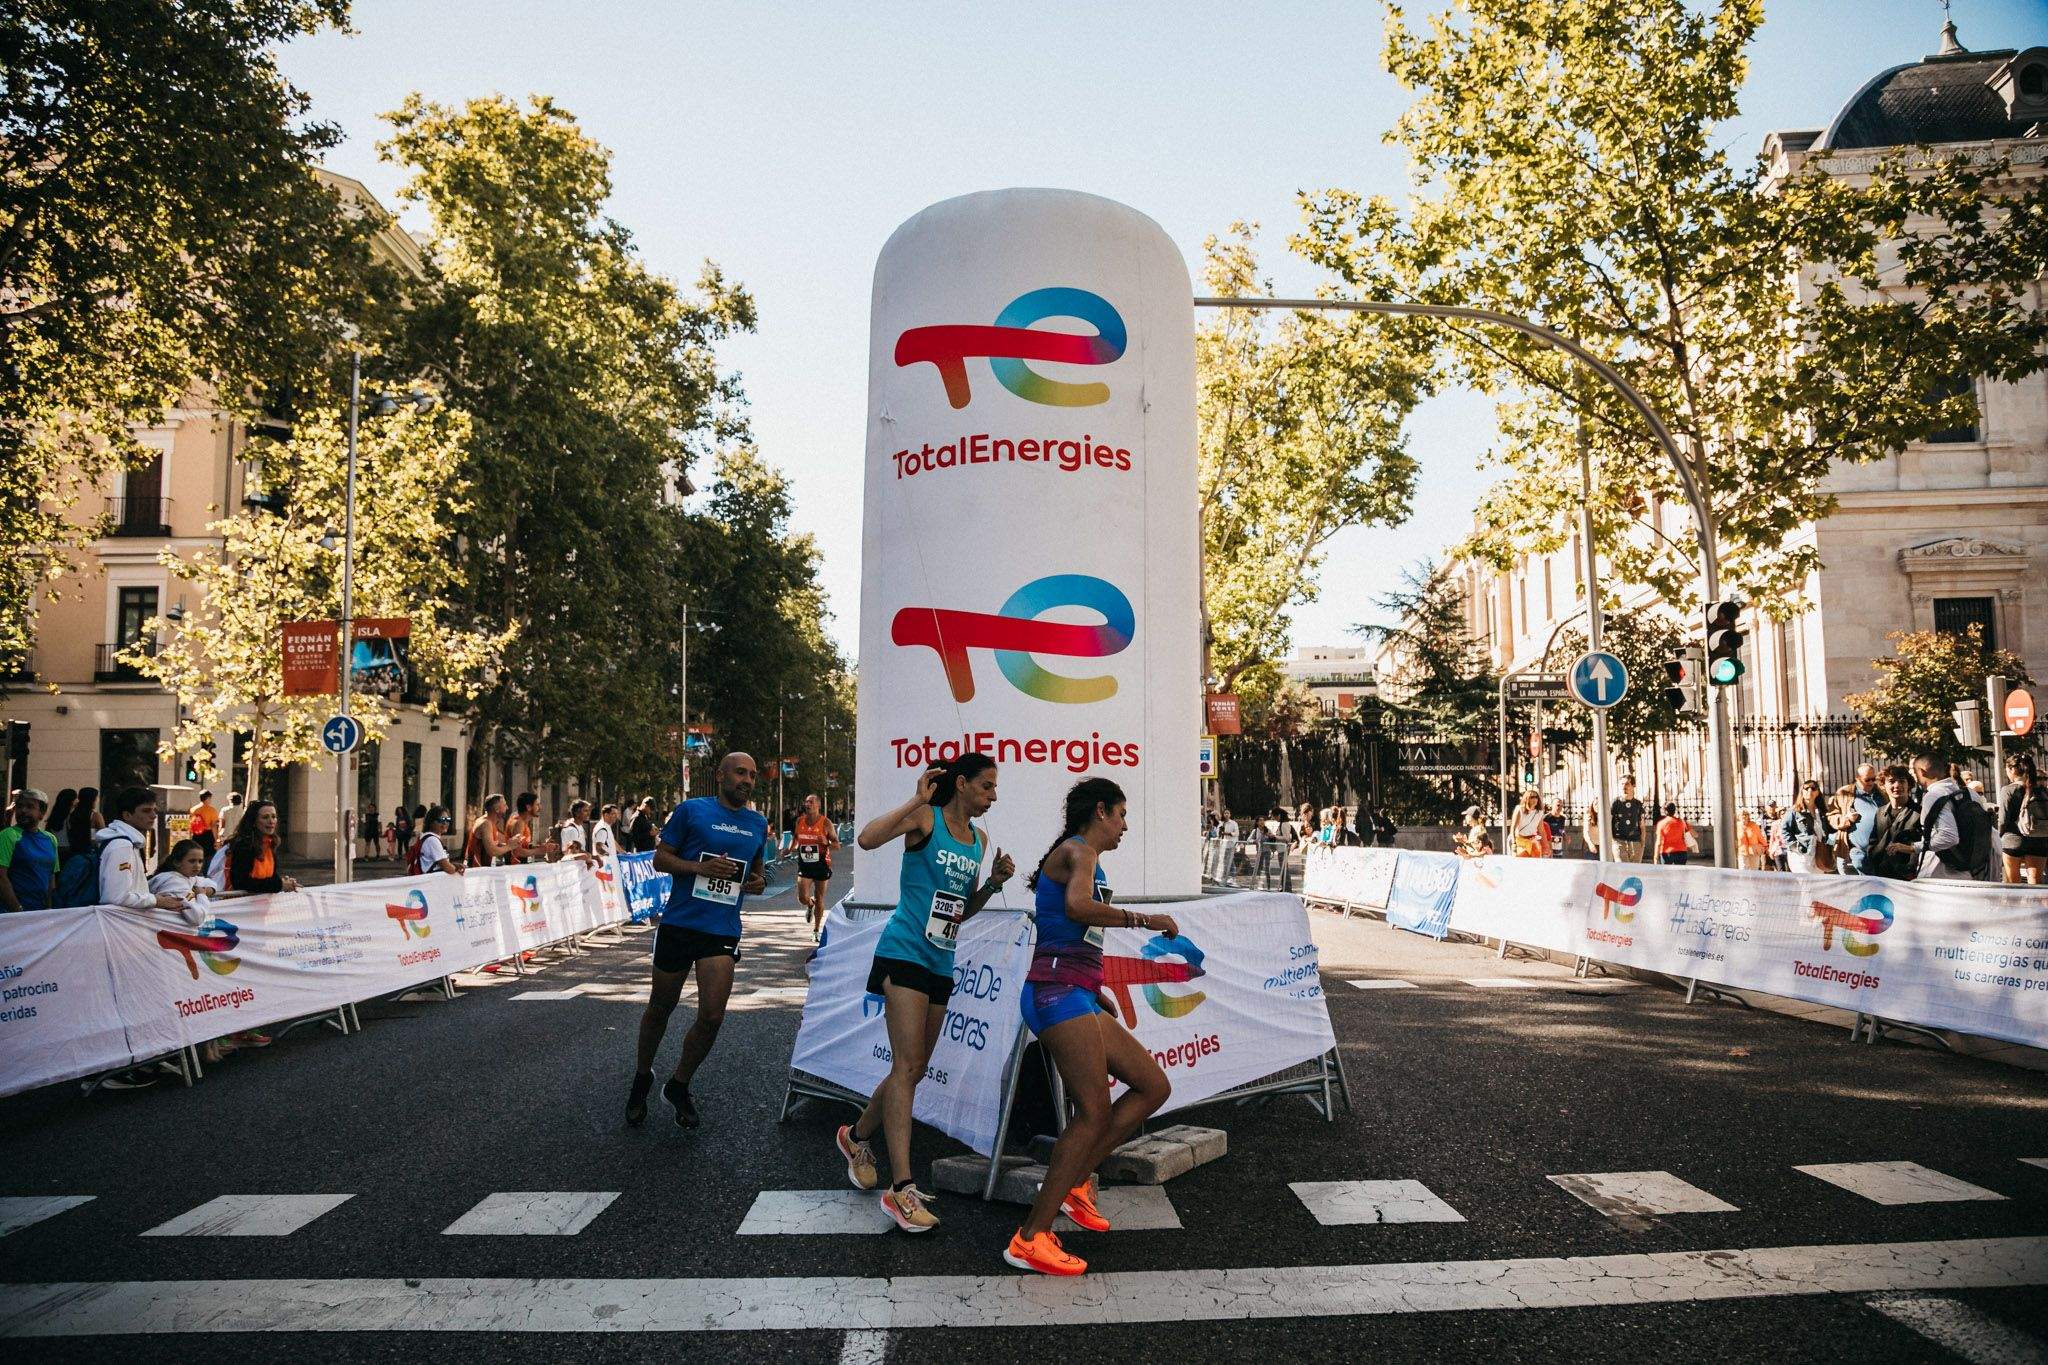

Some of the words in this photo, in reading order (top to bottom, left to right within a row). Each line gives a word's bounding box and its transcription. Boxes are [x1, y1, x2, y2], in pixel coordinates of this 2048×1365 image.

[892, 434, 1132, 480] TotalEnergies
[287, 632, 332, 644] FERNÁN
[357, 627, 381, 636] ISLA
[287, 643, 331, 653] GÓMEZ
[707, 879, 732, 895] 595
[935, 900, 954, 913] 3205
[1586, 927, 1634, 948] TotalEnergies
[1970, 931, 2009, 946] Somos
[2011, 934, 2022, 947] la
[397, 947, 442, 968] TotalEnergies
[1793, 960, 1880, 990] TotalEnergies
[1954, 968, 1972, 981] tus
[1974, 971, 2022, 988] carreras
[2, 981, 59, 1003] patrocina
[174, 986, 255, 1018] TotalEnergies
